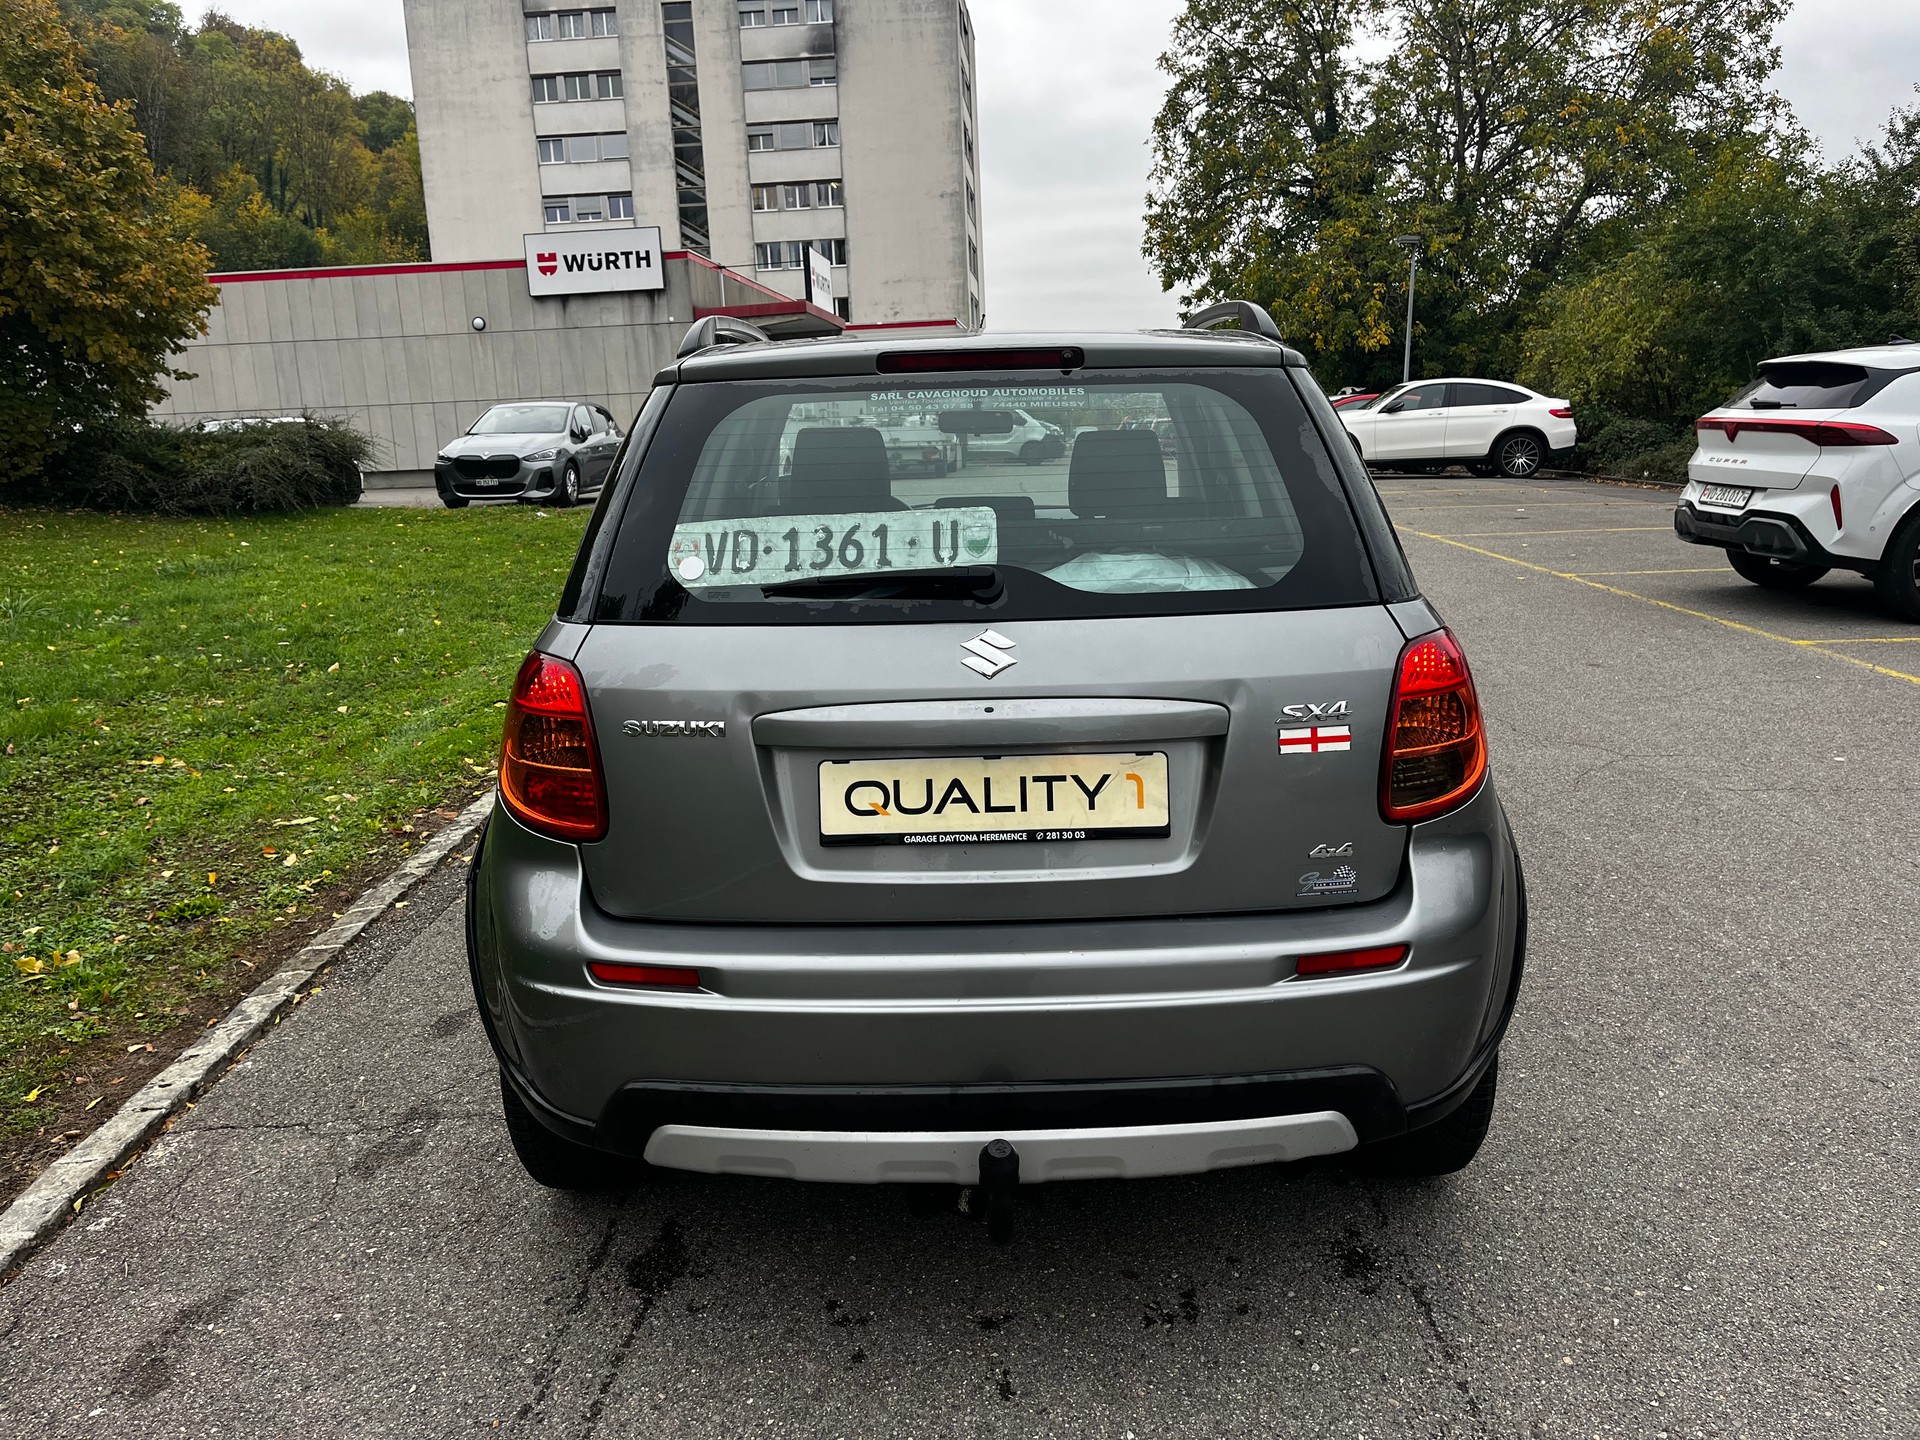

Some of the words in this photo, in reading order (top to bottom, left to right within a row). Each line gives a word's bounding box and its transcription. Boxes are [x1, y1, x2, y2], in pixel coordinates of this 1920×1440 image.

[563, 250, 651, 272] WÜRTH
[870, 392, 903, 400] SARL
[907, 389, 988, 399] CAVAGNOUD
[992, 388, 1085, 396] AUTOMOBILES
[1275, 700, 1352, 723] SX4
[622, 719, 726, 737] SUZUKI
[844, 773, 1112, 817] QUALITY
[904, 834, 938, 843] GARAGE
[939, 833, 978, 842] DAYTONA
[979, 832, 1027, 842] HEREMENCE
[1046, 832, 1060, 840] 281
[1062, 831, 1073, 839] 30
[1074, 831, 1085, 839] 03
[1308, 842, 1353, 858] 4x4
